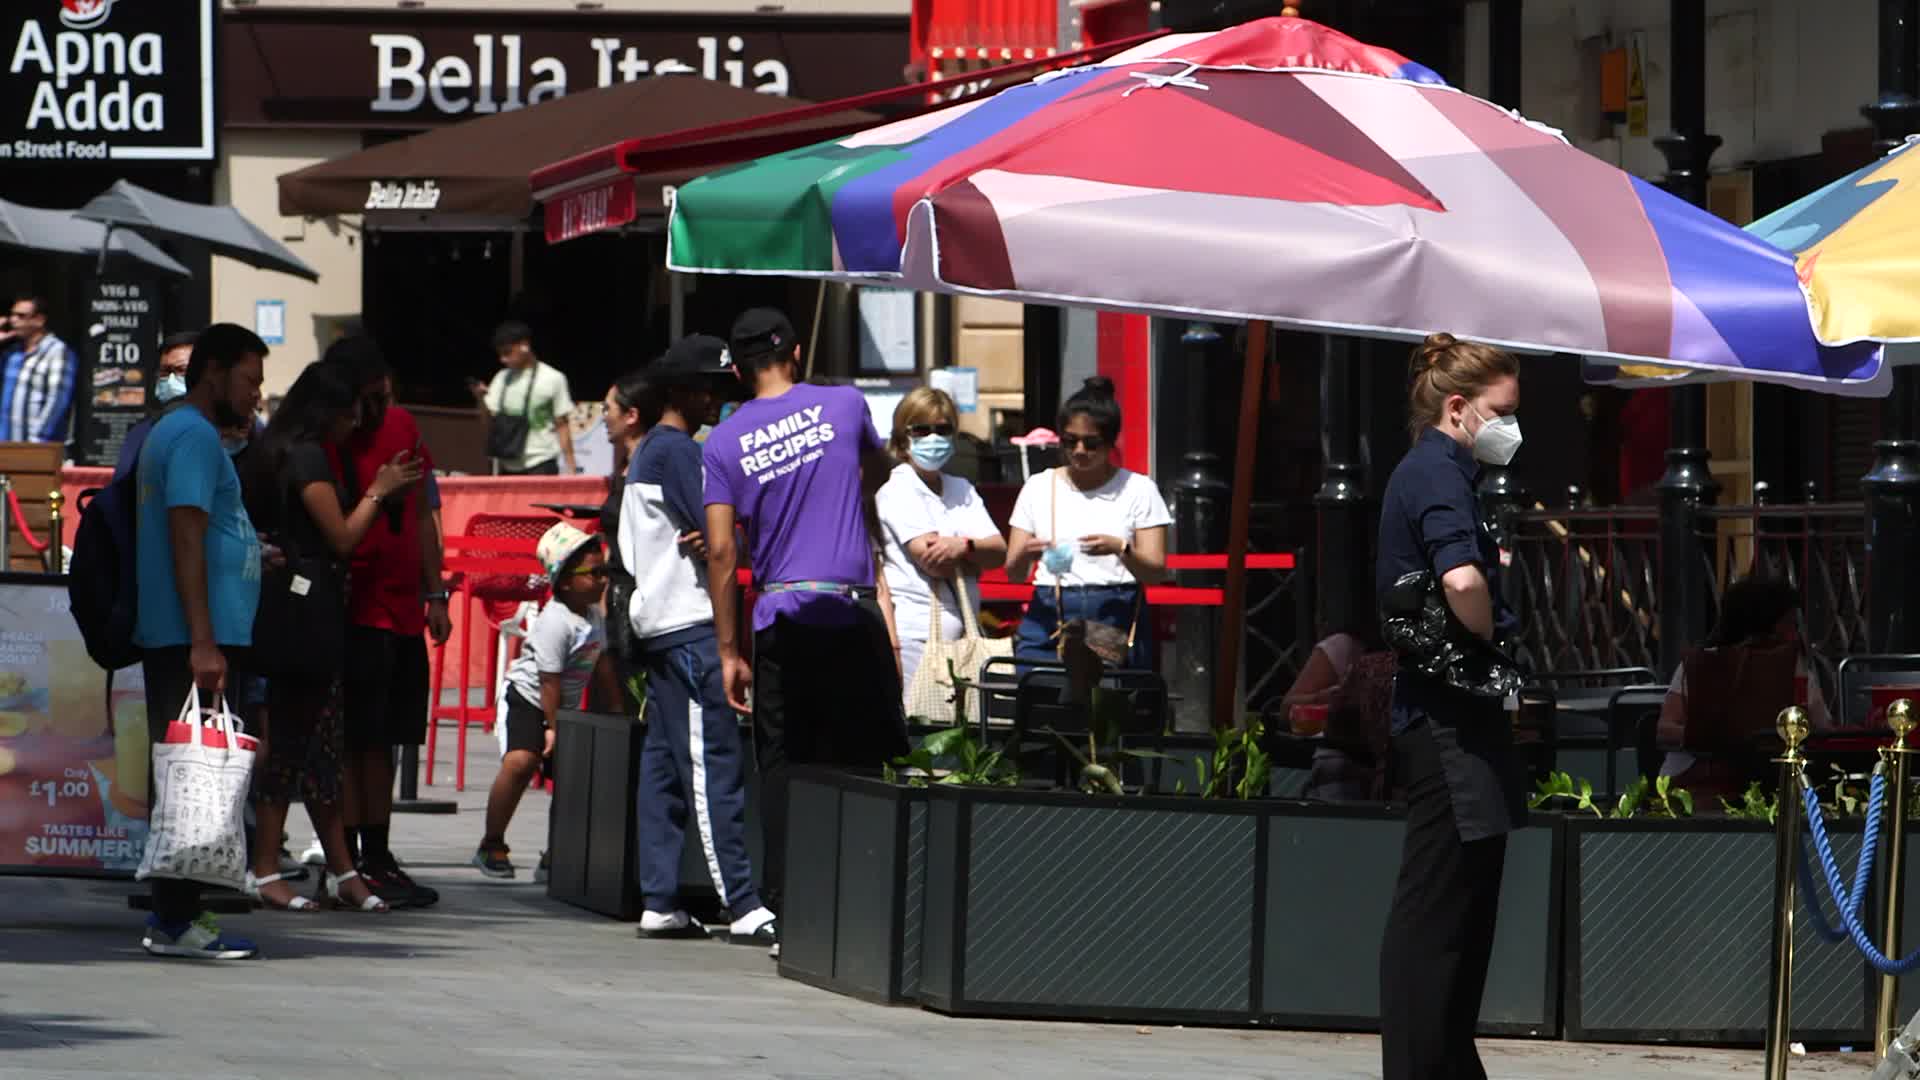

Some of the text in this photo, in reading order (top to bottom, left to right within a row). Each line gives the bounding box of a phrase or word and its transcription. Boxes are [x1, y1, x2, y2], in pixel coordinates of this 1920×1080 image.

[10, 20, 163, 89] Apna
[370, 35, 789, 114] Bella Itlia
[26, 80, 164, 131] Adda
[14, 140, 63, 158] Street
[66, 140, 107, 158] Food
[365, 180, 440, 208] Bella Italia
[100, 284, 127, 298] VEG
[100, 343, 140, 363] £10
[739, 405, 823, 453] FAMILY
[739, 423, 835, 477] RECIPES
[29, 780, 89, 807] £1.00
[41, 824, 126, 838] TASTES LIKE
[24, 836, 142, 858] SUMMER!
